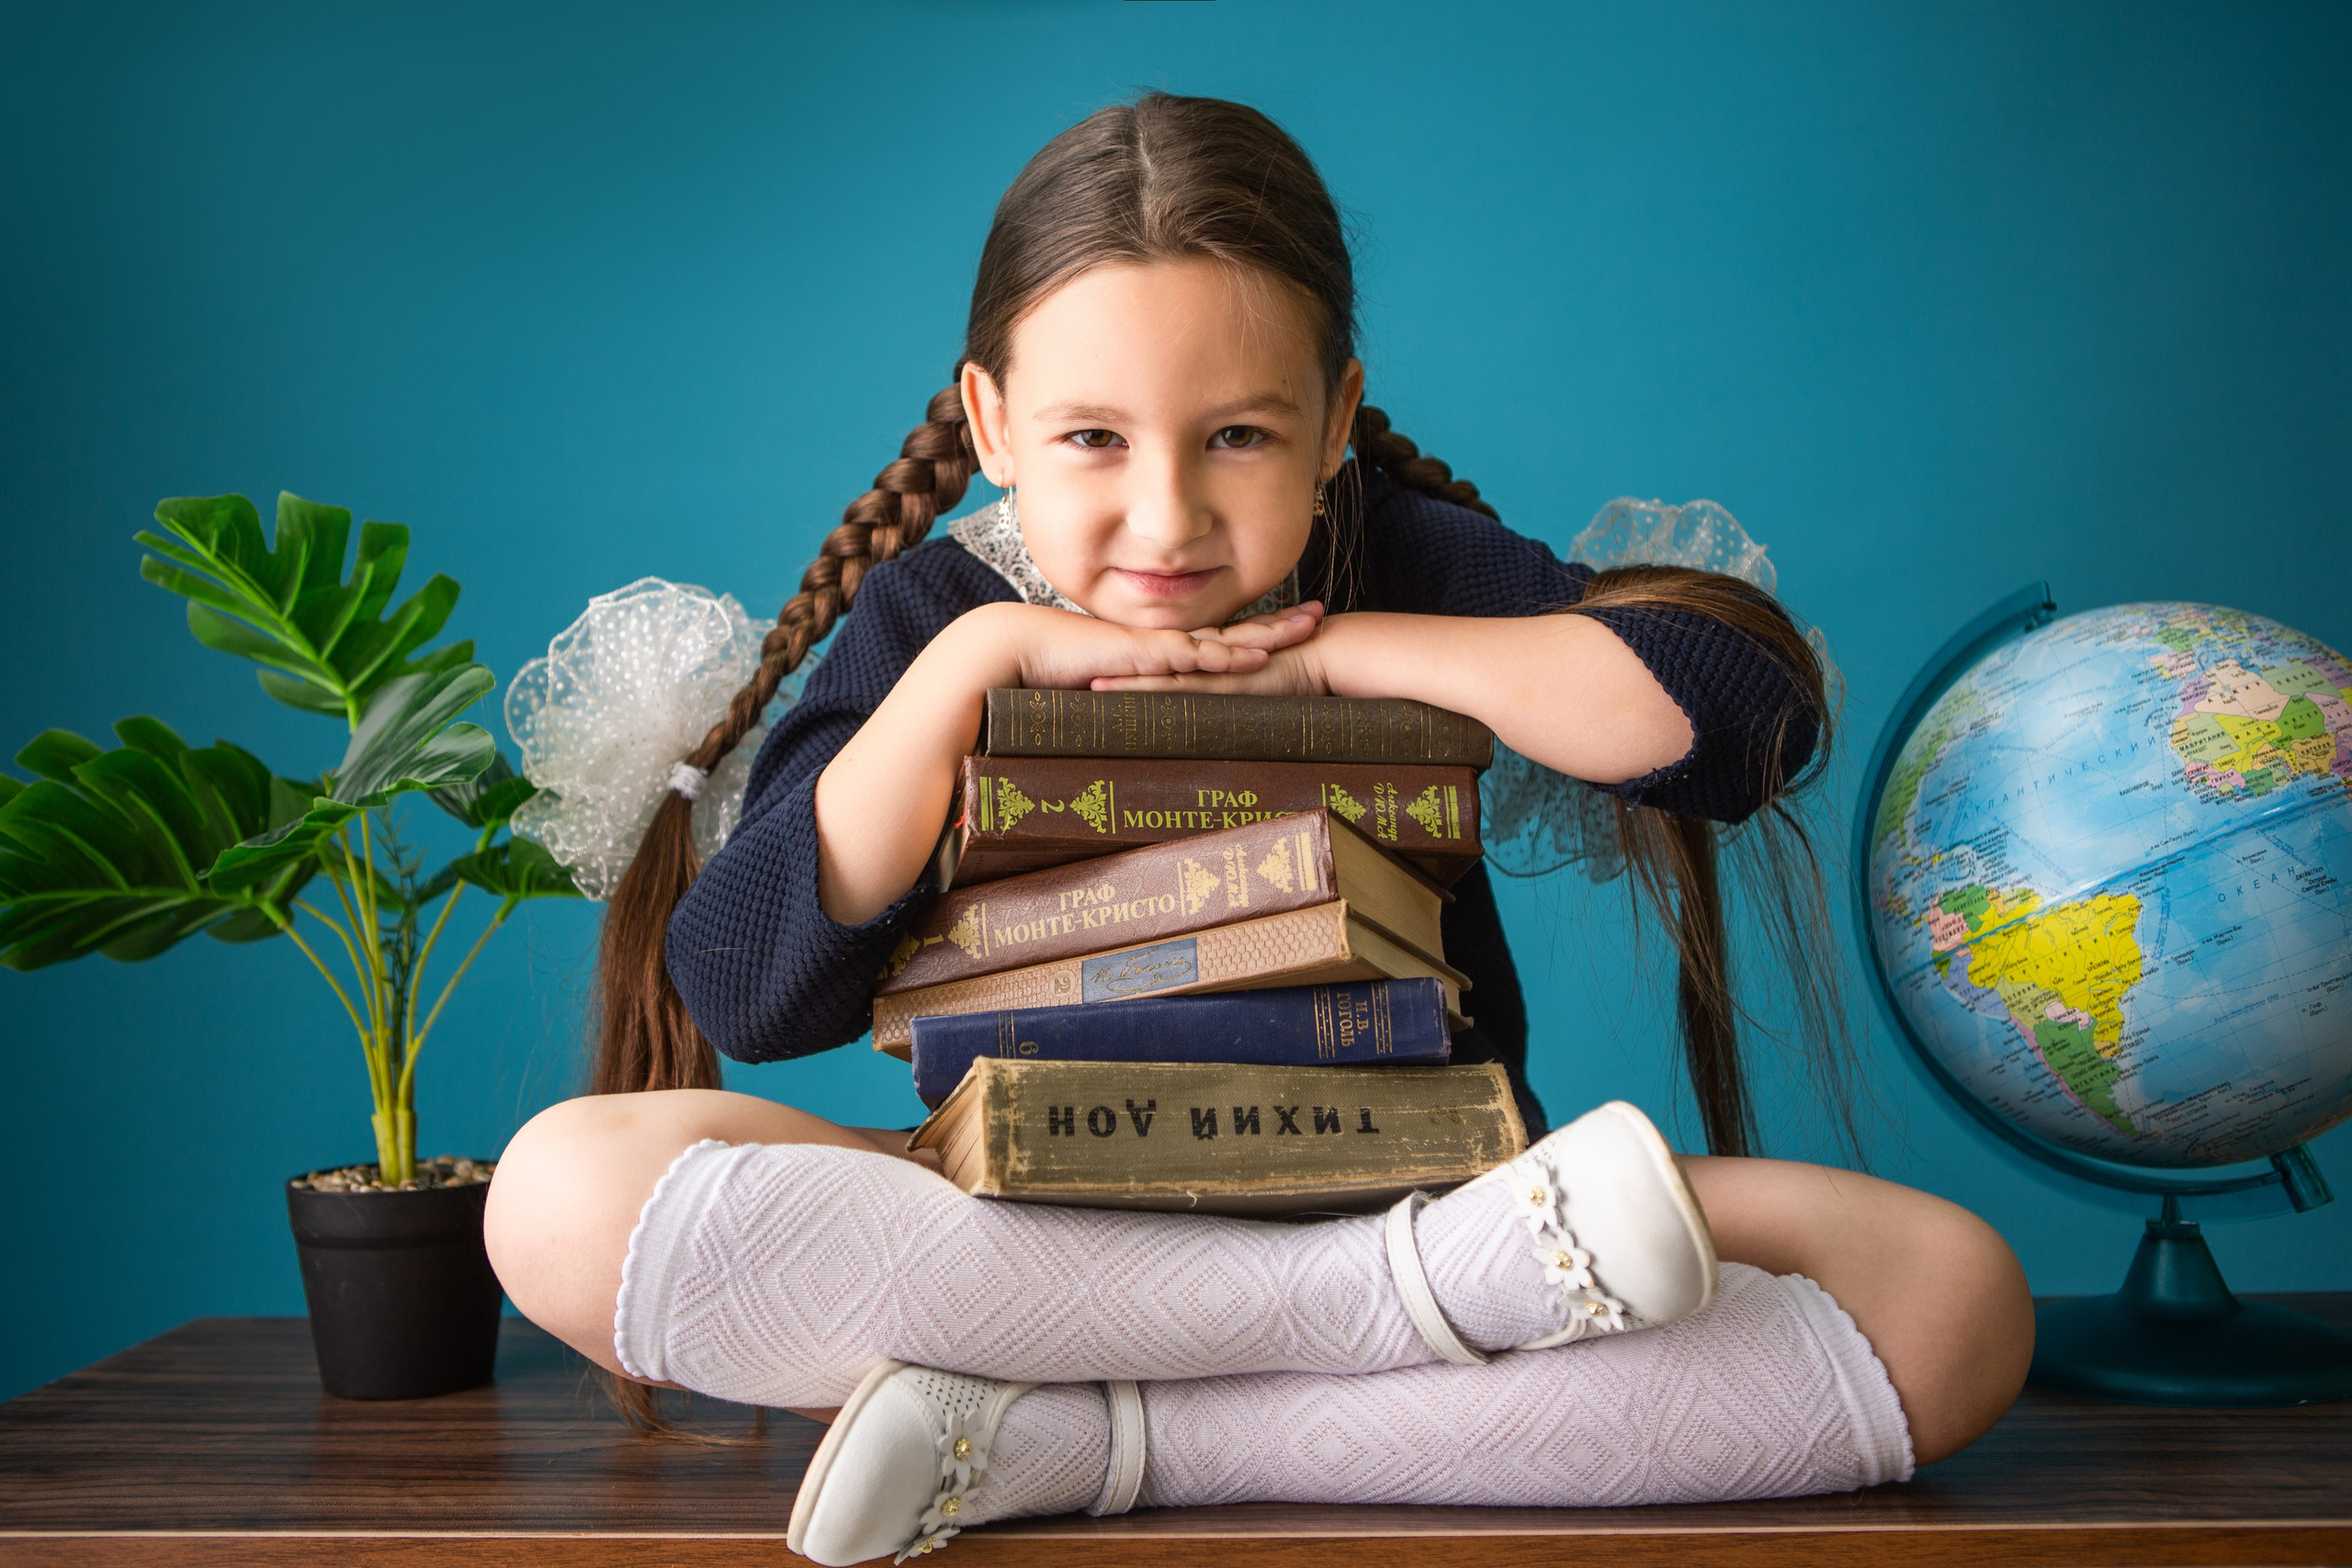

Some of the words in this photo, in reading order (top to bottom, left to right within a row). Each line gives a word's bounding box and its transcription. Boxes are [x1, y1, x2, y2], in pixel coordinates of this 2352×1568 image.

[2178, 730, 2226, 751] МАВРИТАНИЯ
[1041, 799, 1065, 814] 2
[1197, 790, 1258, 808] ГРАФ
[1123, 809, 1300, 829] МОНТЕ-КРИ
[1059, 883, 1116, 912] ГРАФ
[2218, 866, 2295, 902] ОКЕАН
[993, 893, 1176, 949] МОНТЕ-КРИСТО
[1054, 976, 1071, 996] 2
[1337, 992, 1355, 1047] ГОГОЛЬ
[1355, 1000, 1369, 1035] Н.В.
[1019, 1040, 1039, 1056] 6
[1048, 1100, 1157, 1137] ДОН
[1191, 1105, 1380, 1140] ТИХИЙ
